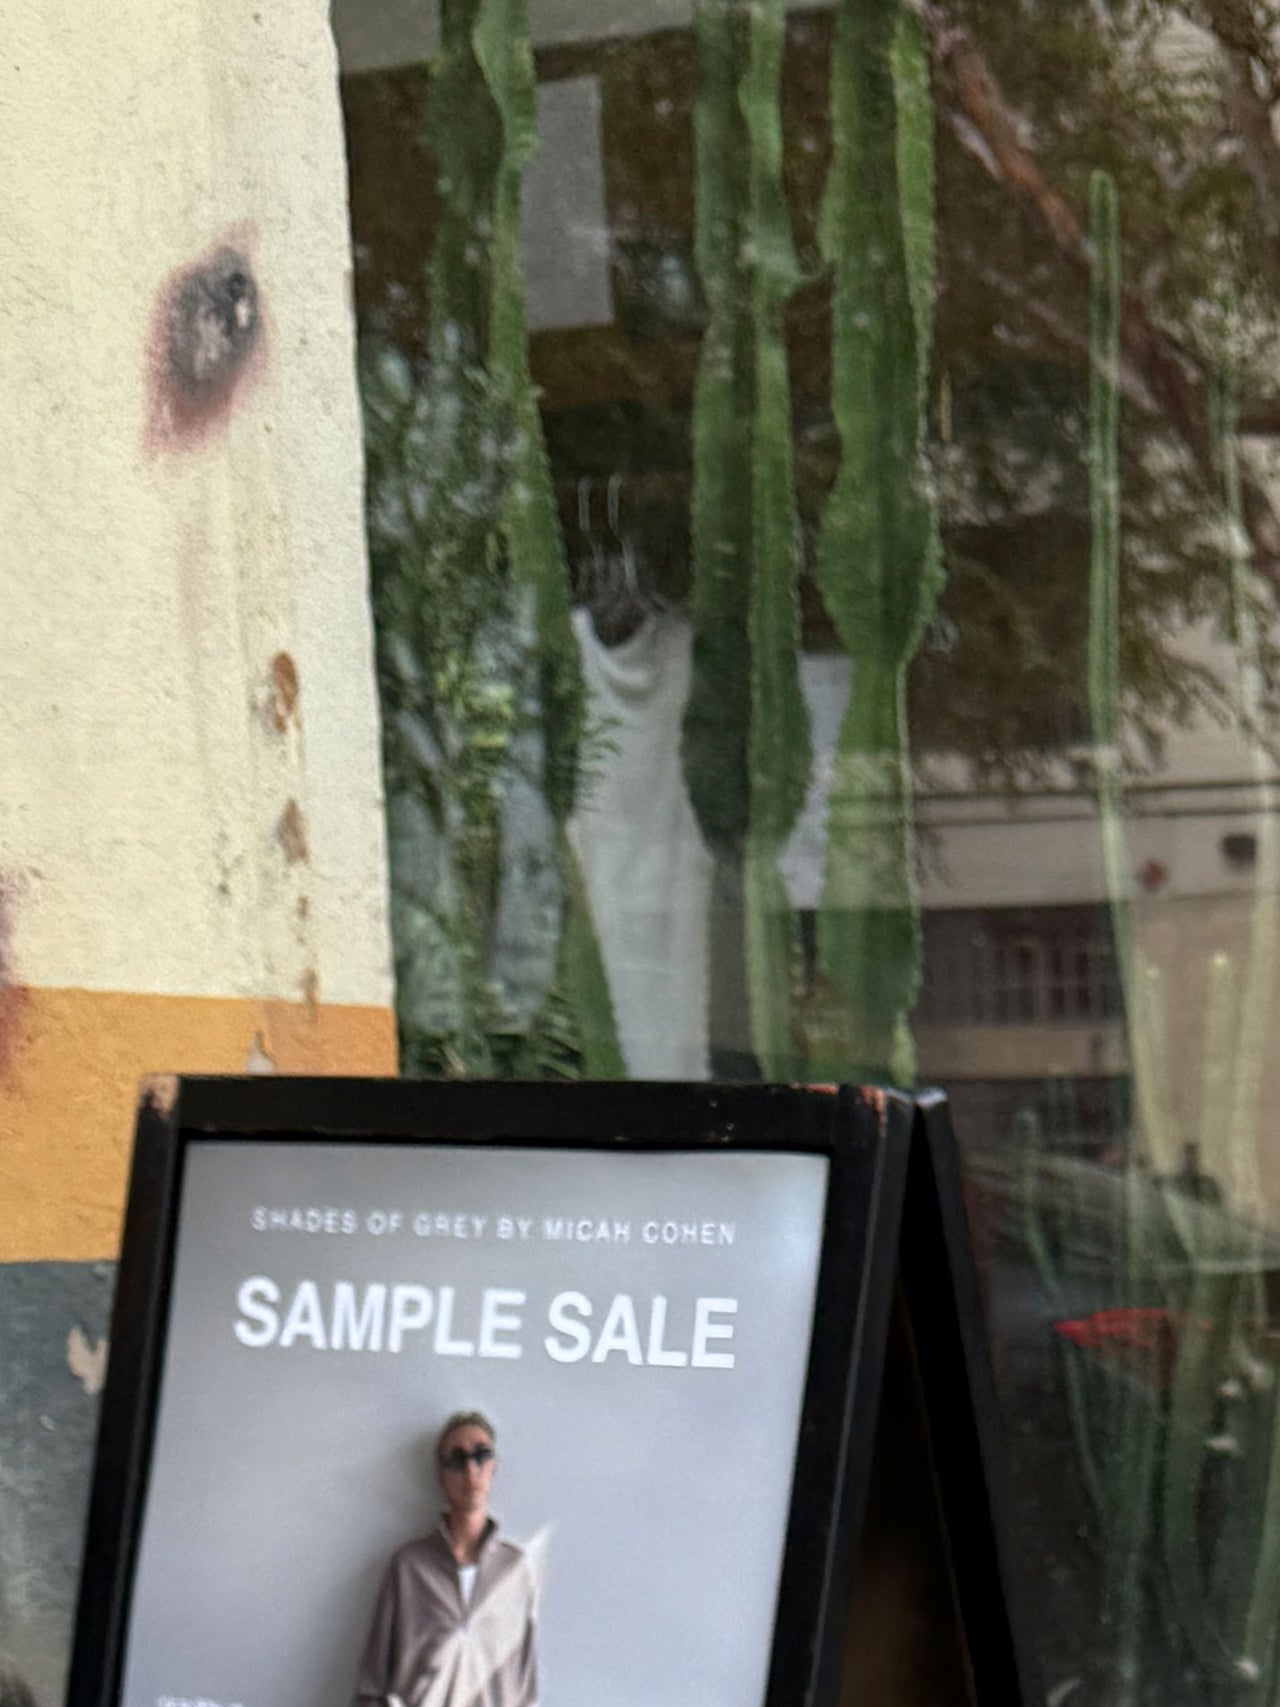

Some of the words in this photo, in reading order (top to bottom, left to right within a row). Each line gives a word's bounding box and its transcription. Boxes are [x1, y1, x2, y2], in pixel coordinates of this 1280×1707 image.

[252, 1206, 358, 1235] SHADES
[366, 1210, 403, 1235] OF
[413, 1212, 488, 1238] GREY
[495, 1217, 534, 1240] BY
[542, 1217, 632, 1243] MICAH
[641, 1221, 737, 1245] COHEN
[233, 1275, 526, 1359] SAMPLE
[544, 1290, 738, 1369] SALE
